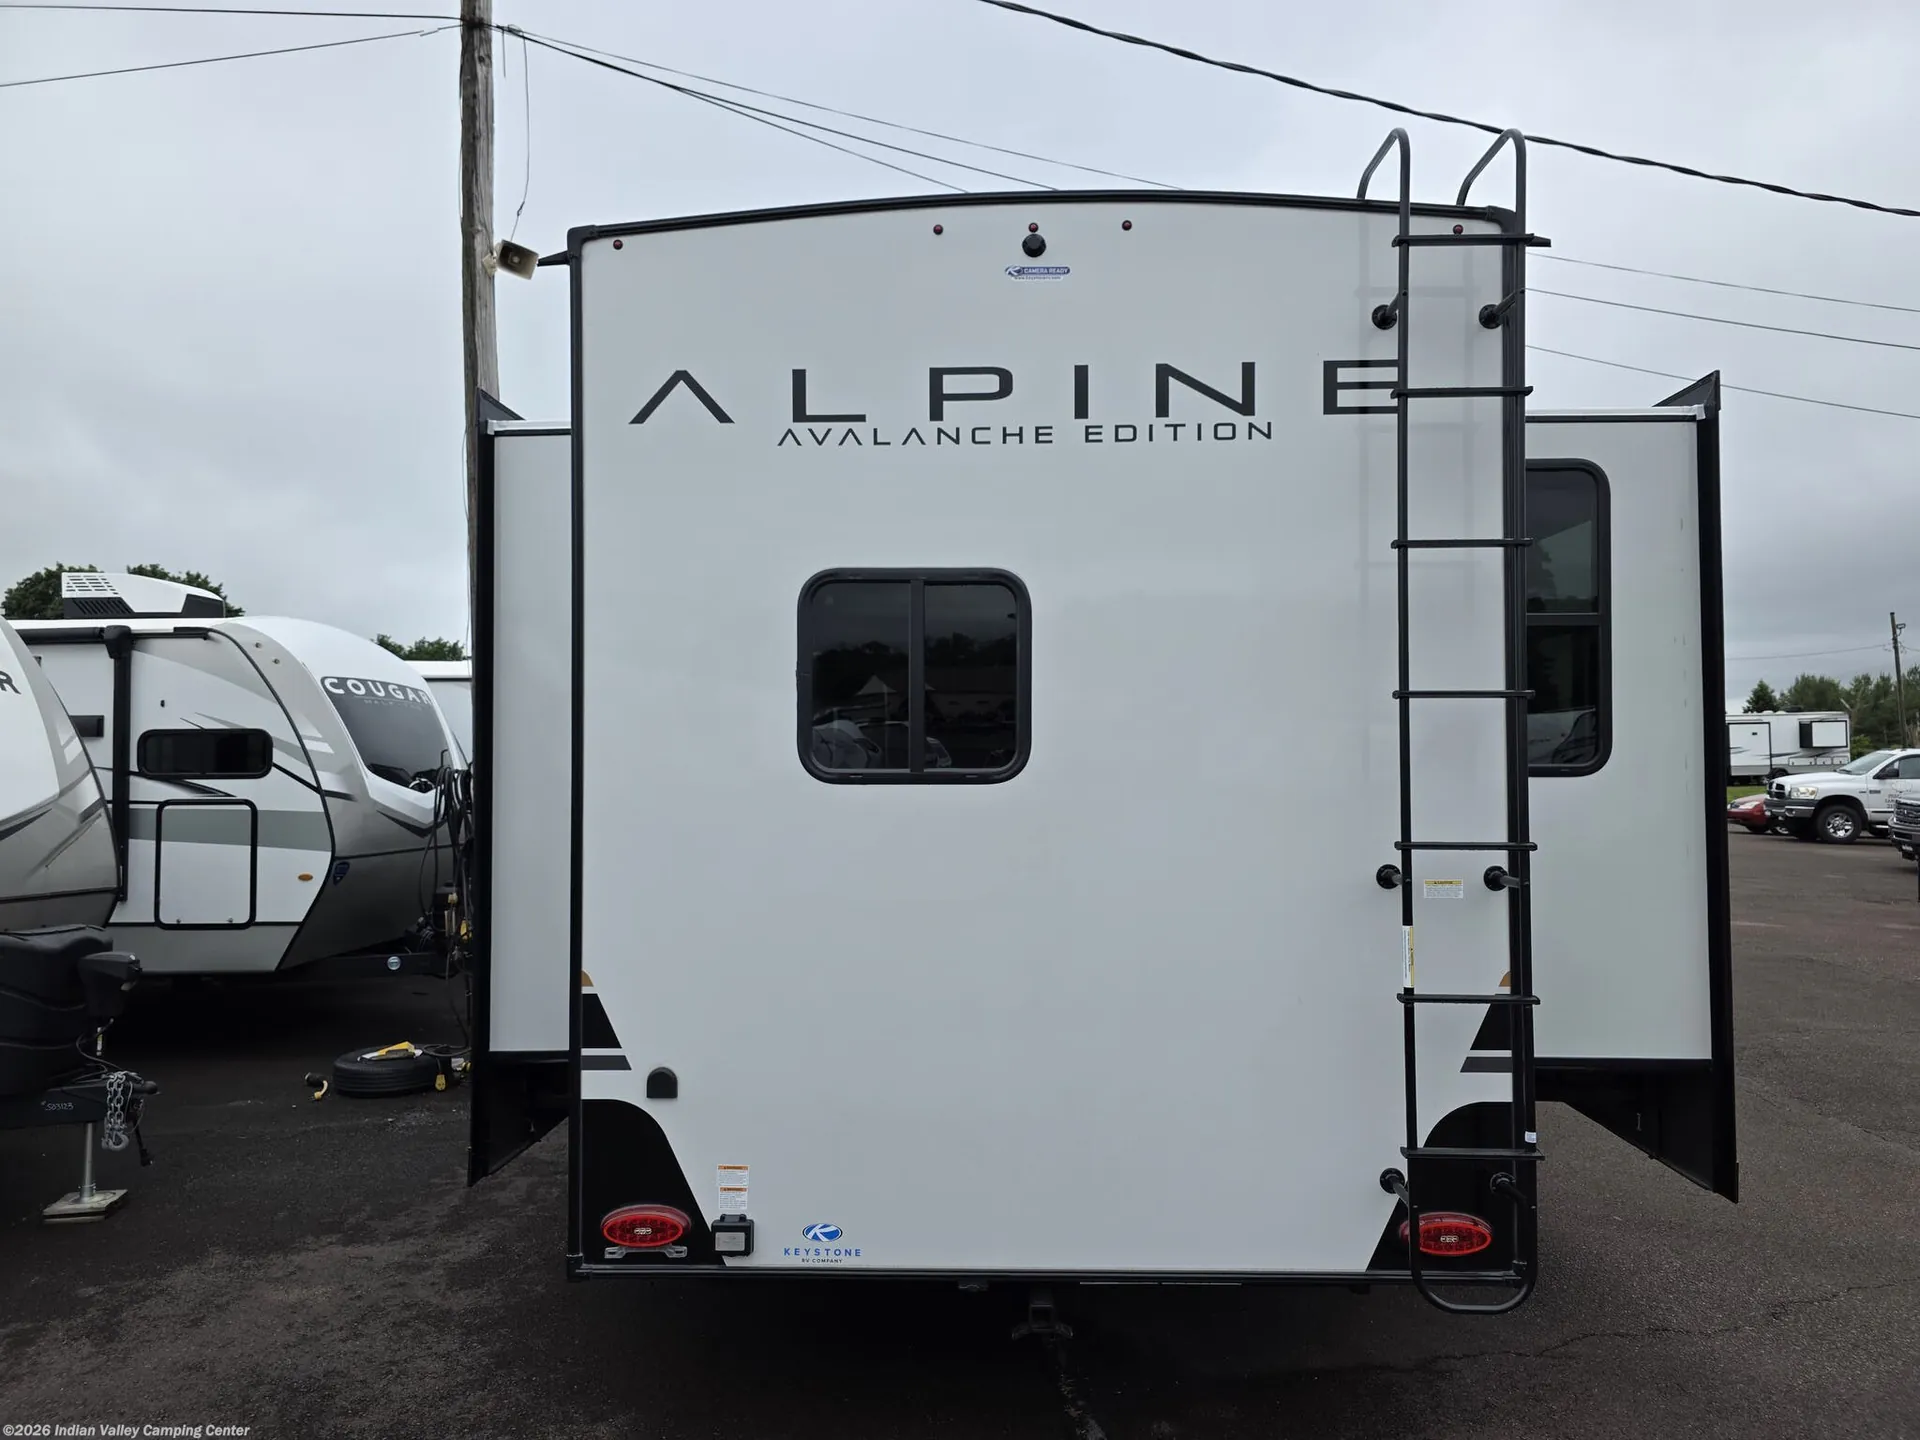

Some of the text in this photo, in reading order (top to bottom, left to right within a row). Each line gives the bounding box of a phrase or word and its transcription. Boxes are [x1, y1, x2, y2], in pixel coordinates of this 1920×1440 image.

[628, 359, 1399, 424] ALPINE
[777, 421, 1273, 446] AVALANCHE EDITION
[324, 677, 432, 705] COUGAR
[783, 1248, 862, 1257] KEYSTONE
